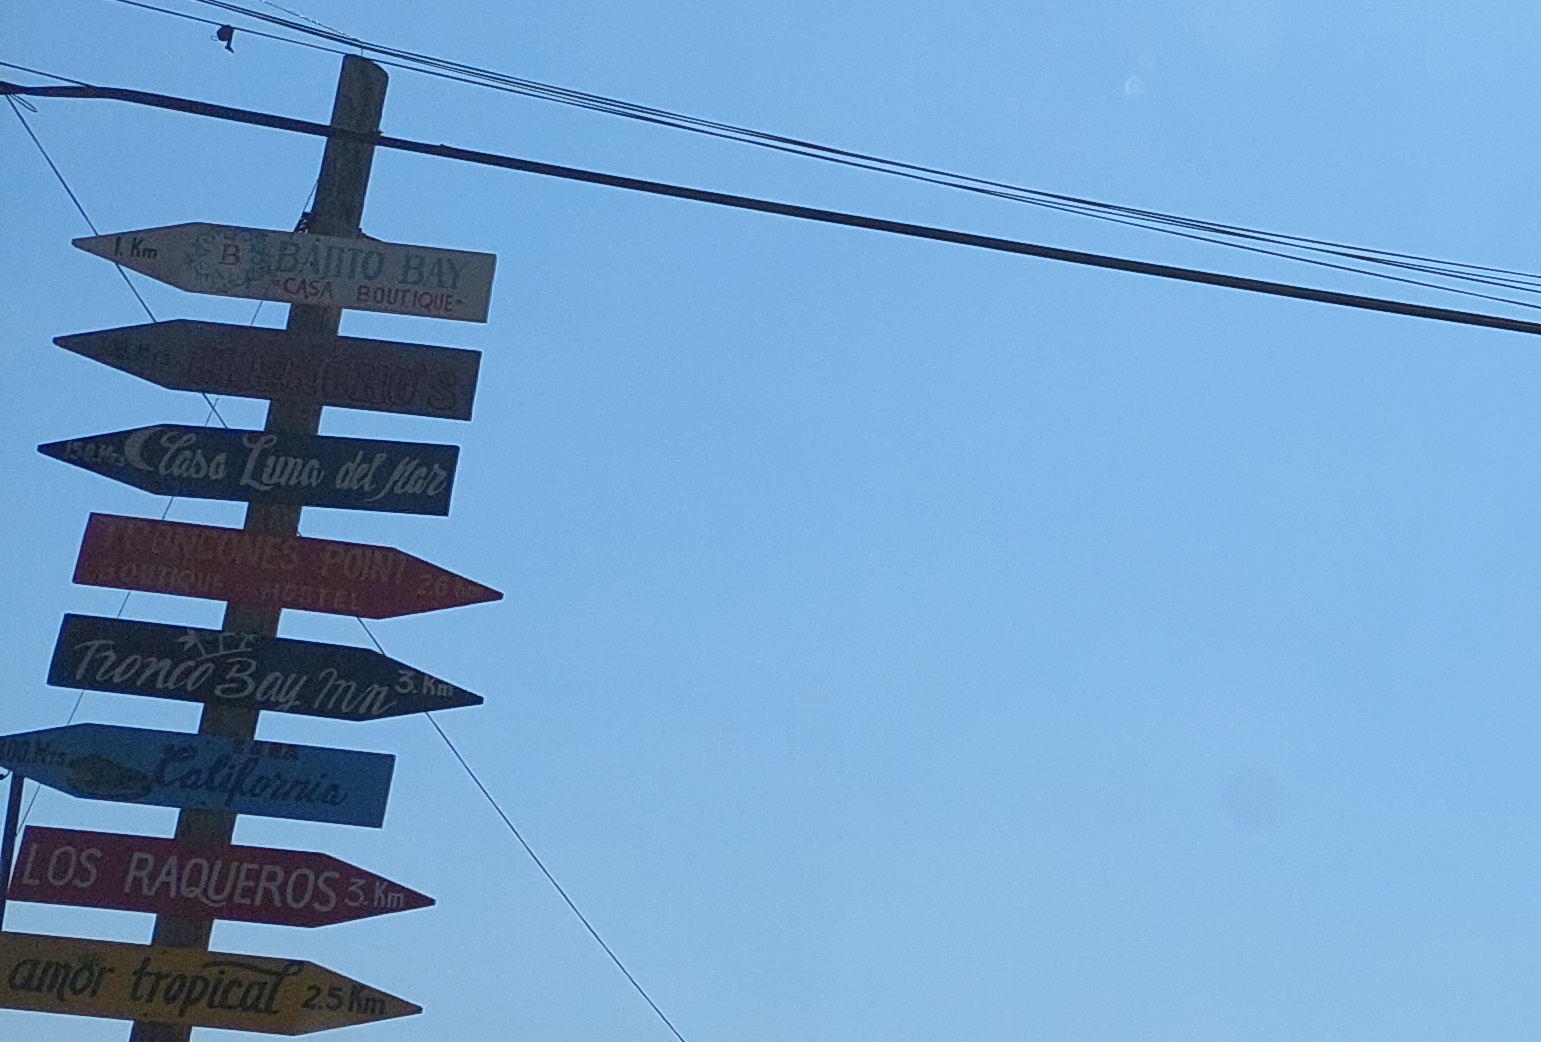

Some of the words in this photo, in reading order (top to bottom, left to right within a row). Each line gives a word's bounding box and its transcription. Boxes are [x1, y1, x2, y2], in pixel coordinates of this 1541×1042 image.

[400, 251, 469, 290] BAY
[161, 431, 231, 481] Casa
[240, 433, 328, 492] Luna
[336, 451, 380, 491] del
[370, 452, 450, 502] Mar
[323, 542, 407, 585] POINT
[261, 581, 362, 611] HOSTEL
[72, 637, 219, 686] Tronco
[214, 657, 302, 711] Bay
[422, 671, 452, 698] Km
[151, 743, 351, 808] California
[22, 843, 101, 888] LOS
[124, 851, 341, 912] RAQUEROS
[375, 877, 404, 909] Km
[8, 956, 114, 1000] amor
[132, 954, 306, 1017] tropical
[347, 990, 386, 1015] Km
